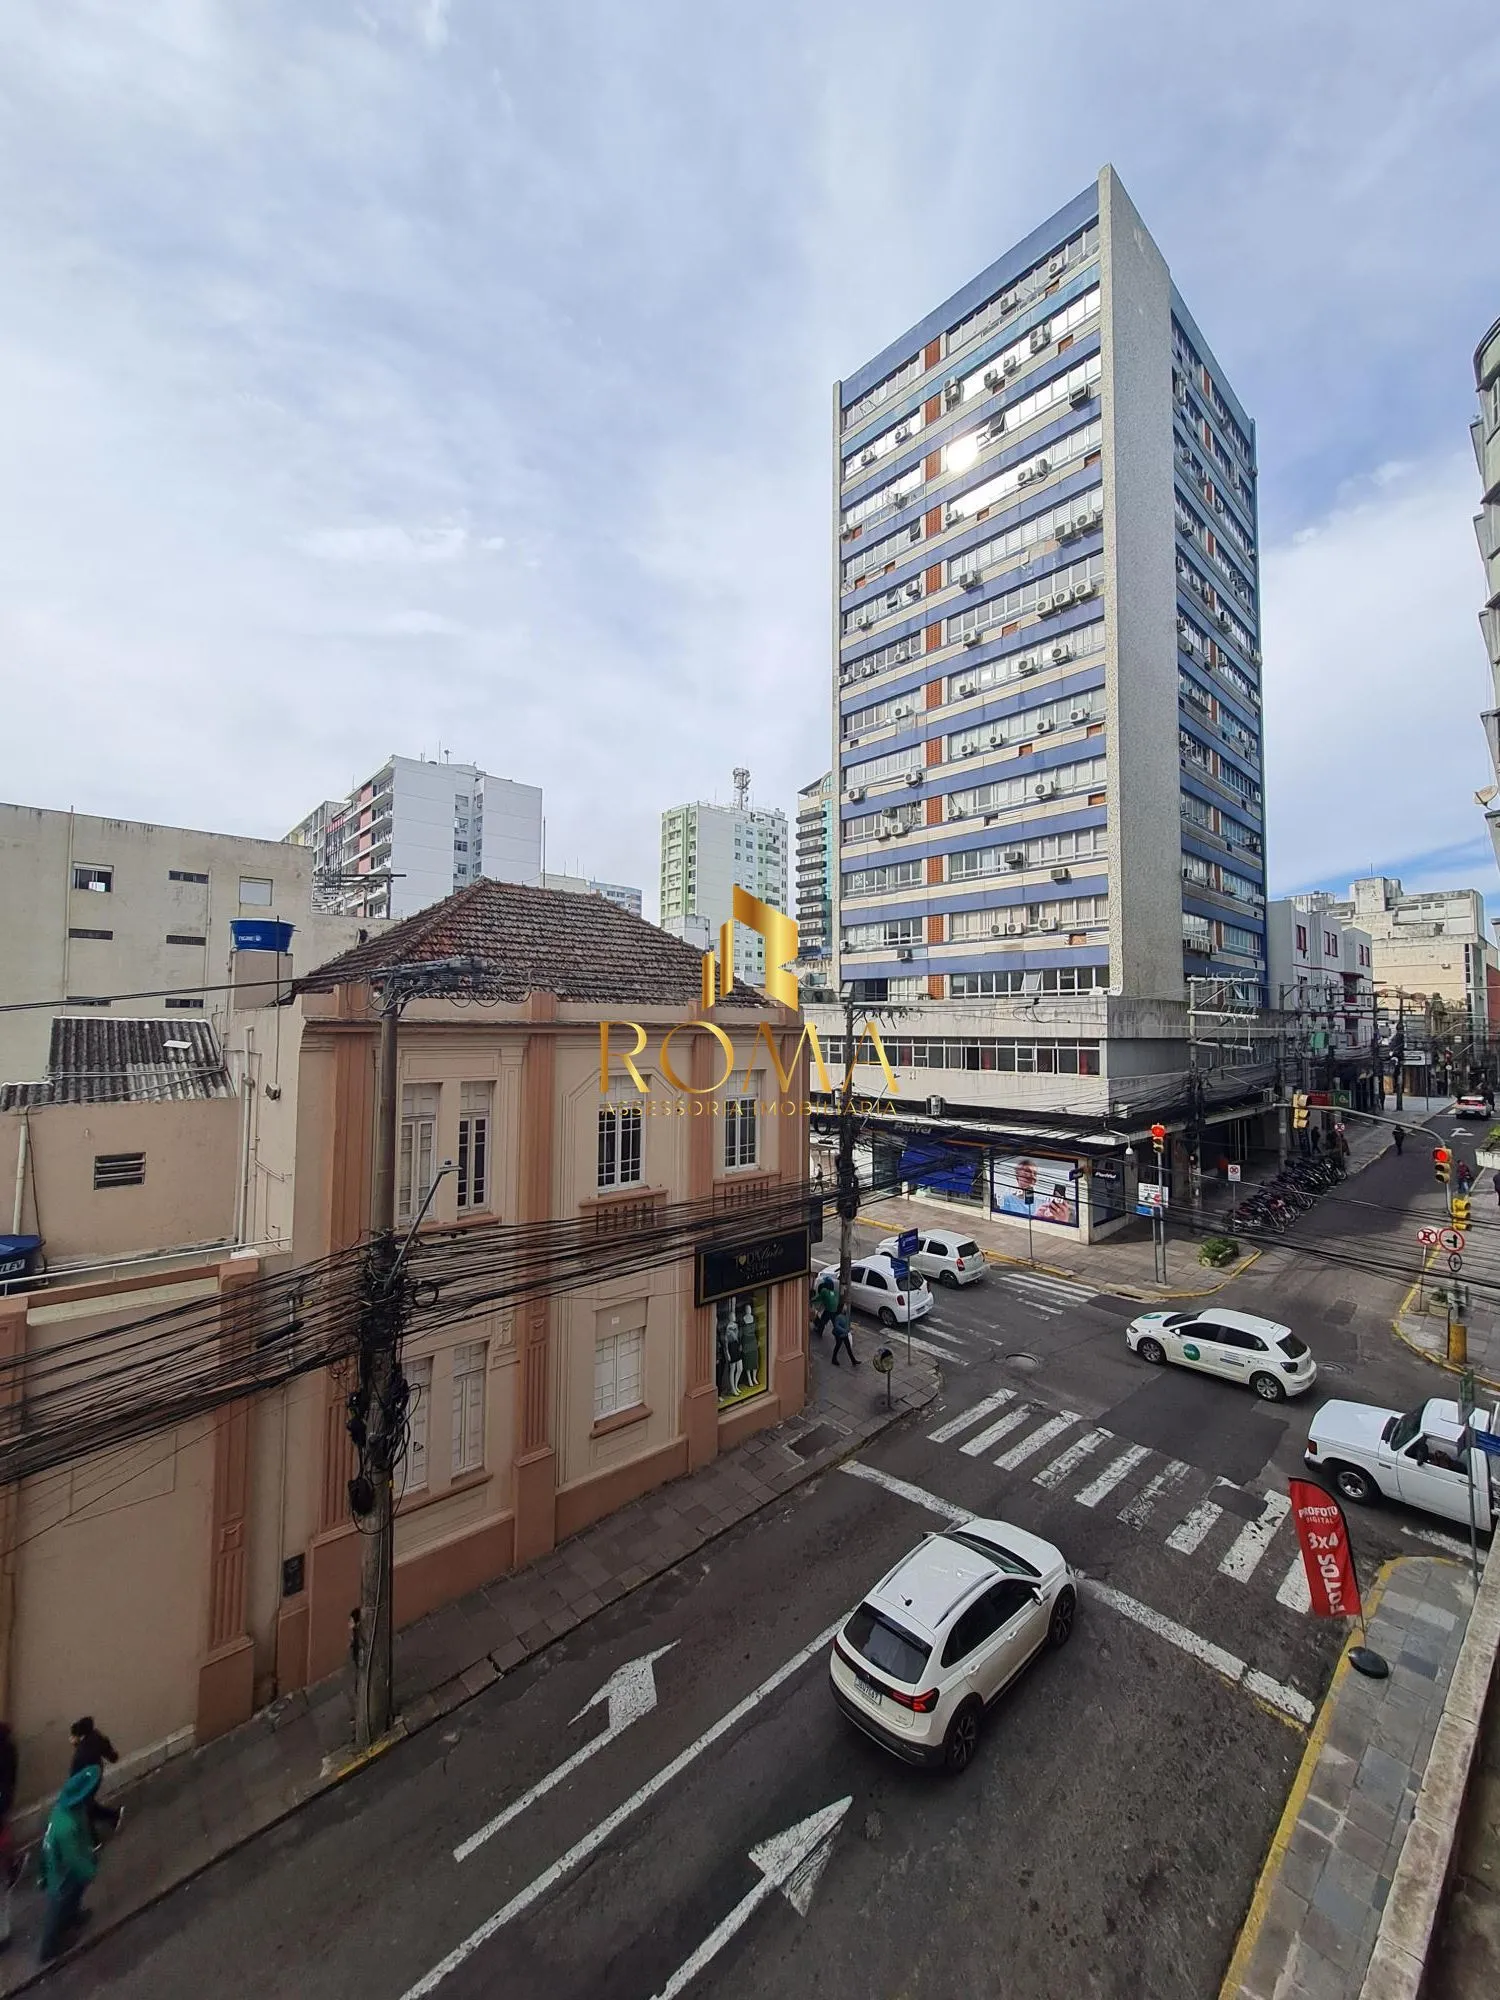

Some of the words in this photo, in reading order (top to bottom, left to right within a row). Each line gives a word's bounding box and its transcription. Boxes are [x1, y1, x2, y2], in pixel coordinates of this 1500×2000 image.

[1298, 1506, 1338, 1518] PROFOTO
[1306, 1516, 1334, 1524] DIGITAL
[1308, 1532, 1339, 1549] 3x4
[1317, 1553, 1345, 1614] FOTOS
